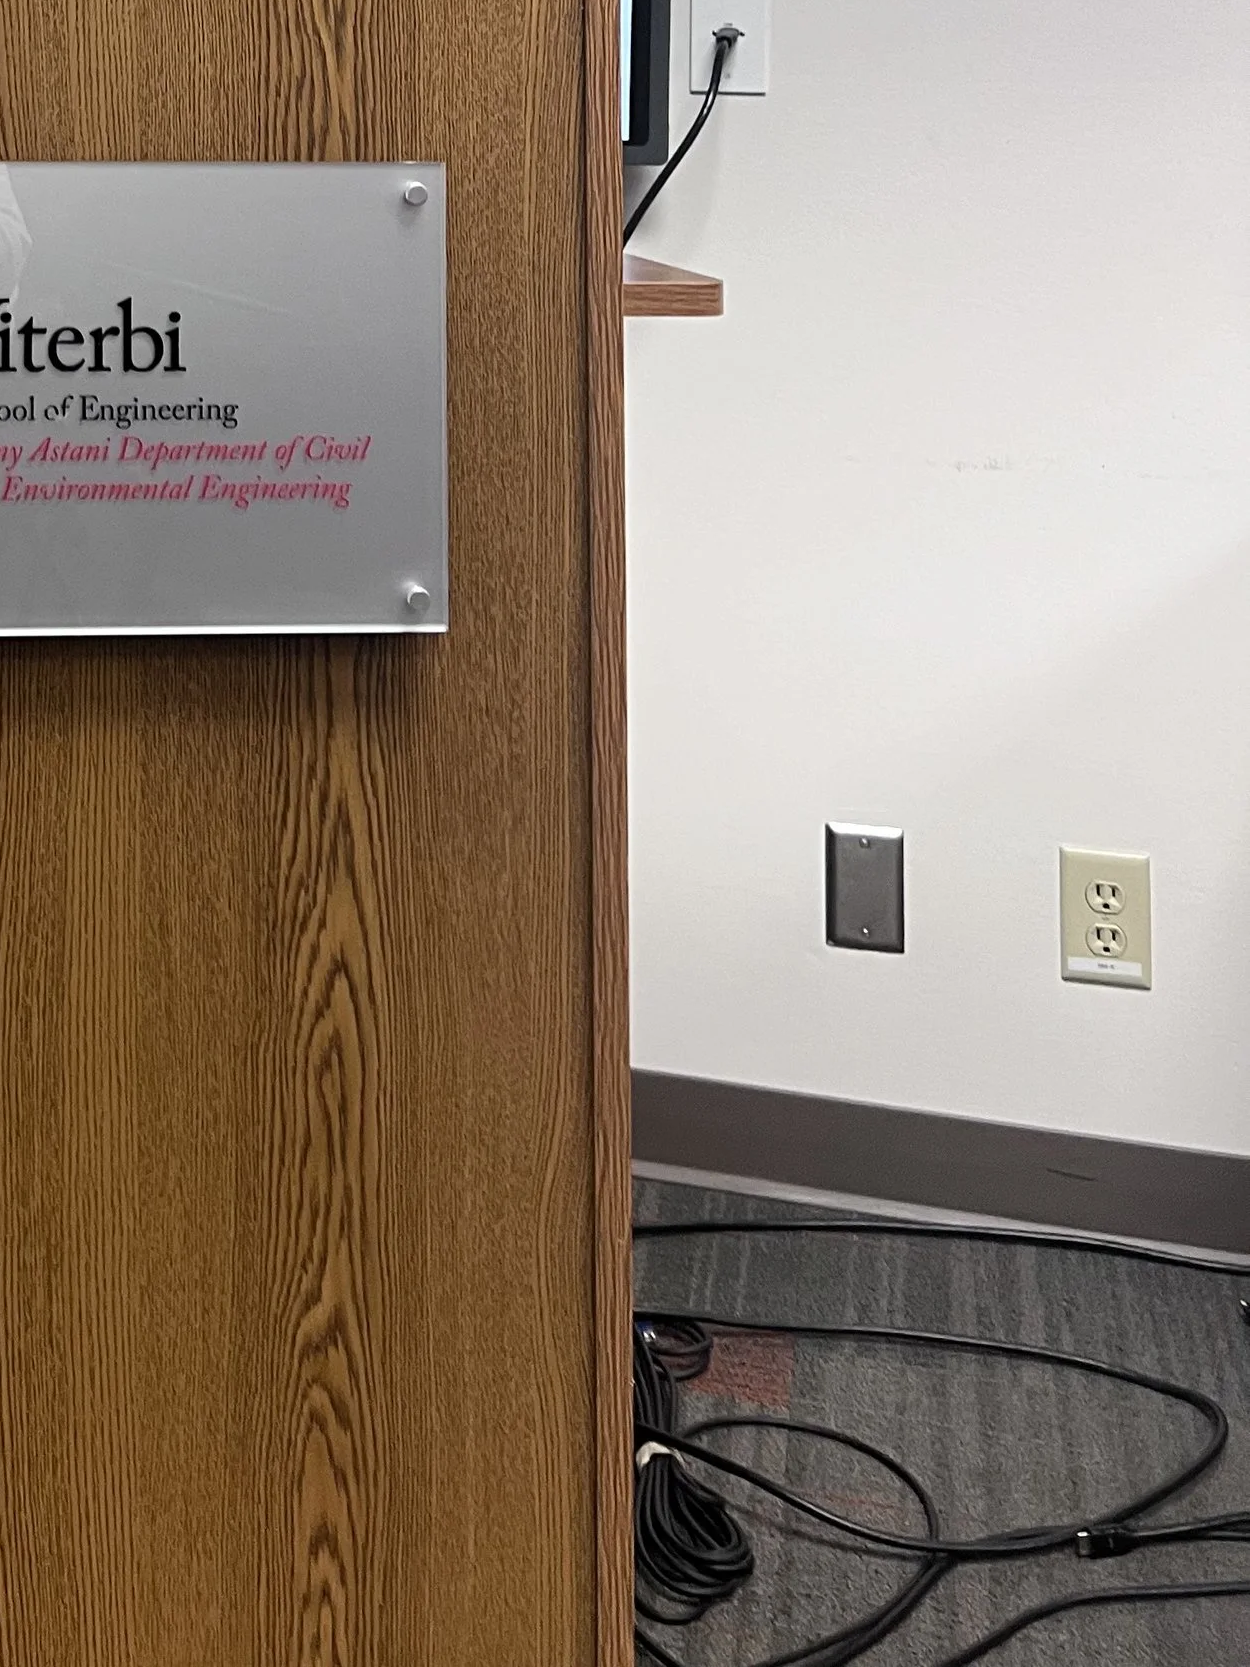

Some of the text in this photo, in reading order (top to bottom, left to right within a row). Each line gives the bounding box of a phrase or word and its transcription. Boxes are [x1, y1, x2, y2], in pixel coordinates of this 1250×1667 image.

[44, 395, 74, 420] of
[79, 395, 239, 429] Engineering
[27, 436, 111, 463] Astani
[117, 435, 268, 471] Department
[274, 435, 304, 472] of
[305, 435, 372, 461] Civil
[1, 475, 195, 503] Environmental
[199, 474, 352, 509] Engineering
